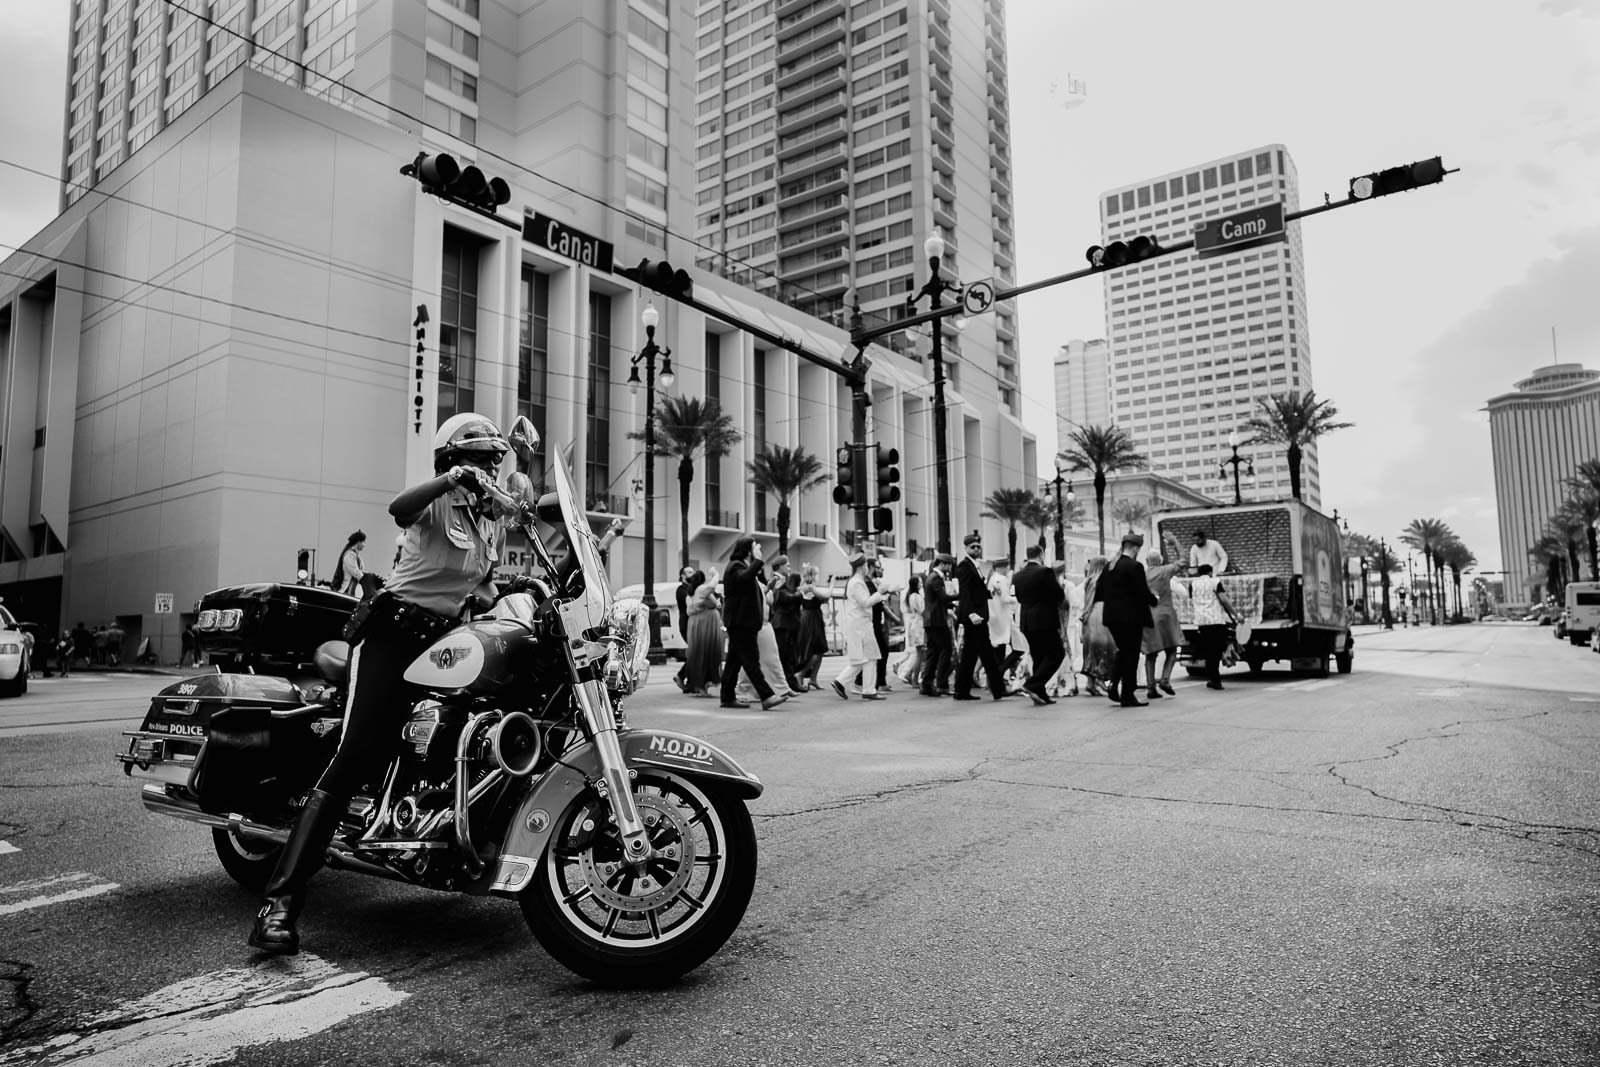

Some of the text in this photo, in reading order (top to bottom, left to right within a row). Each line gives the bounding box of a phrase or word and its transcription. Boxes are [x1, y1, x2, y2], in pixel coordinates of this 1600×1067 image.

[1221, 218, 1267, 240] Camp
[547, 220, 599, 267] Canal
[413, 327, 426, 434] MARRIOTT
[158, 603, 170, 612] 15
[169, 723, 204, 736] POLICE
[649, 735, 713, 762] N.O.P.D.
